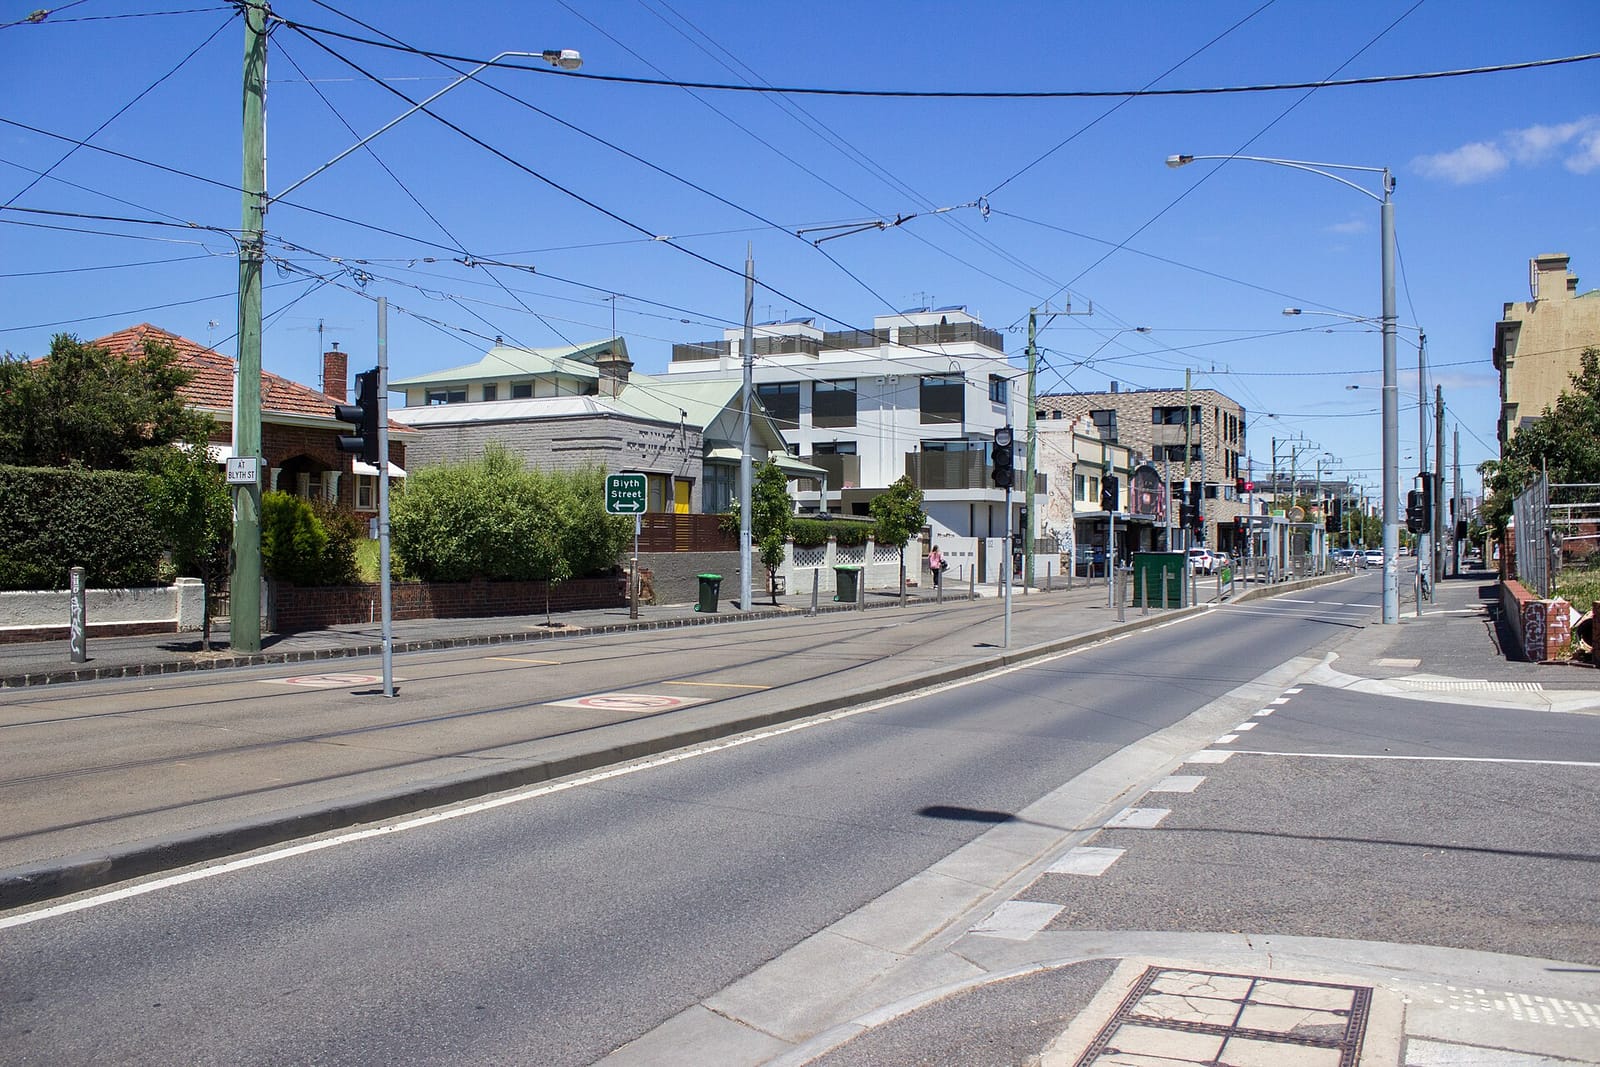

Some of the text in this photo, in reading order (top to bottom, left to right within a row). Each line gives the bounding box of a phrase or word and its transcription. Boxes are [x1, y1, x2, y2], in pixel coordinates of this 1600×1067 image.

[228, 470, 254, 479] BLYTH ST
[613, 480, 640, 488] Blyth
